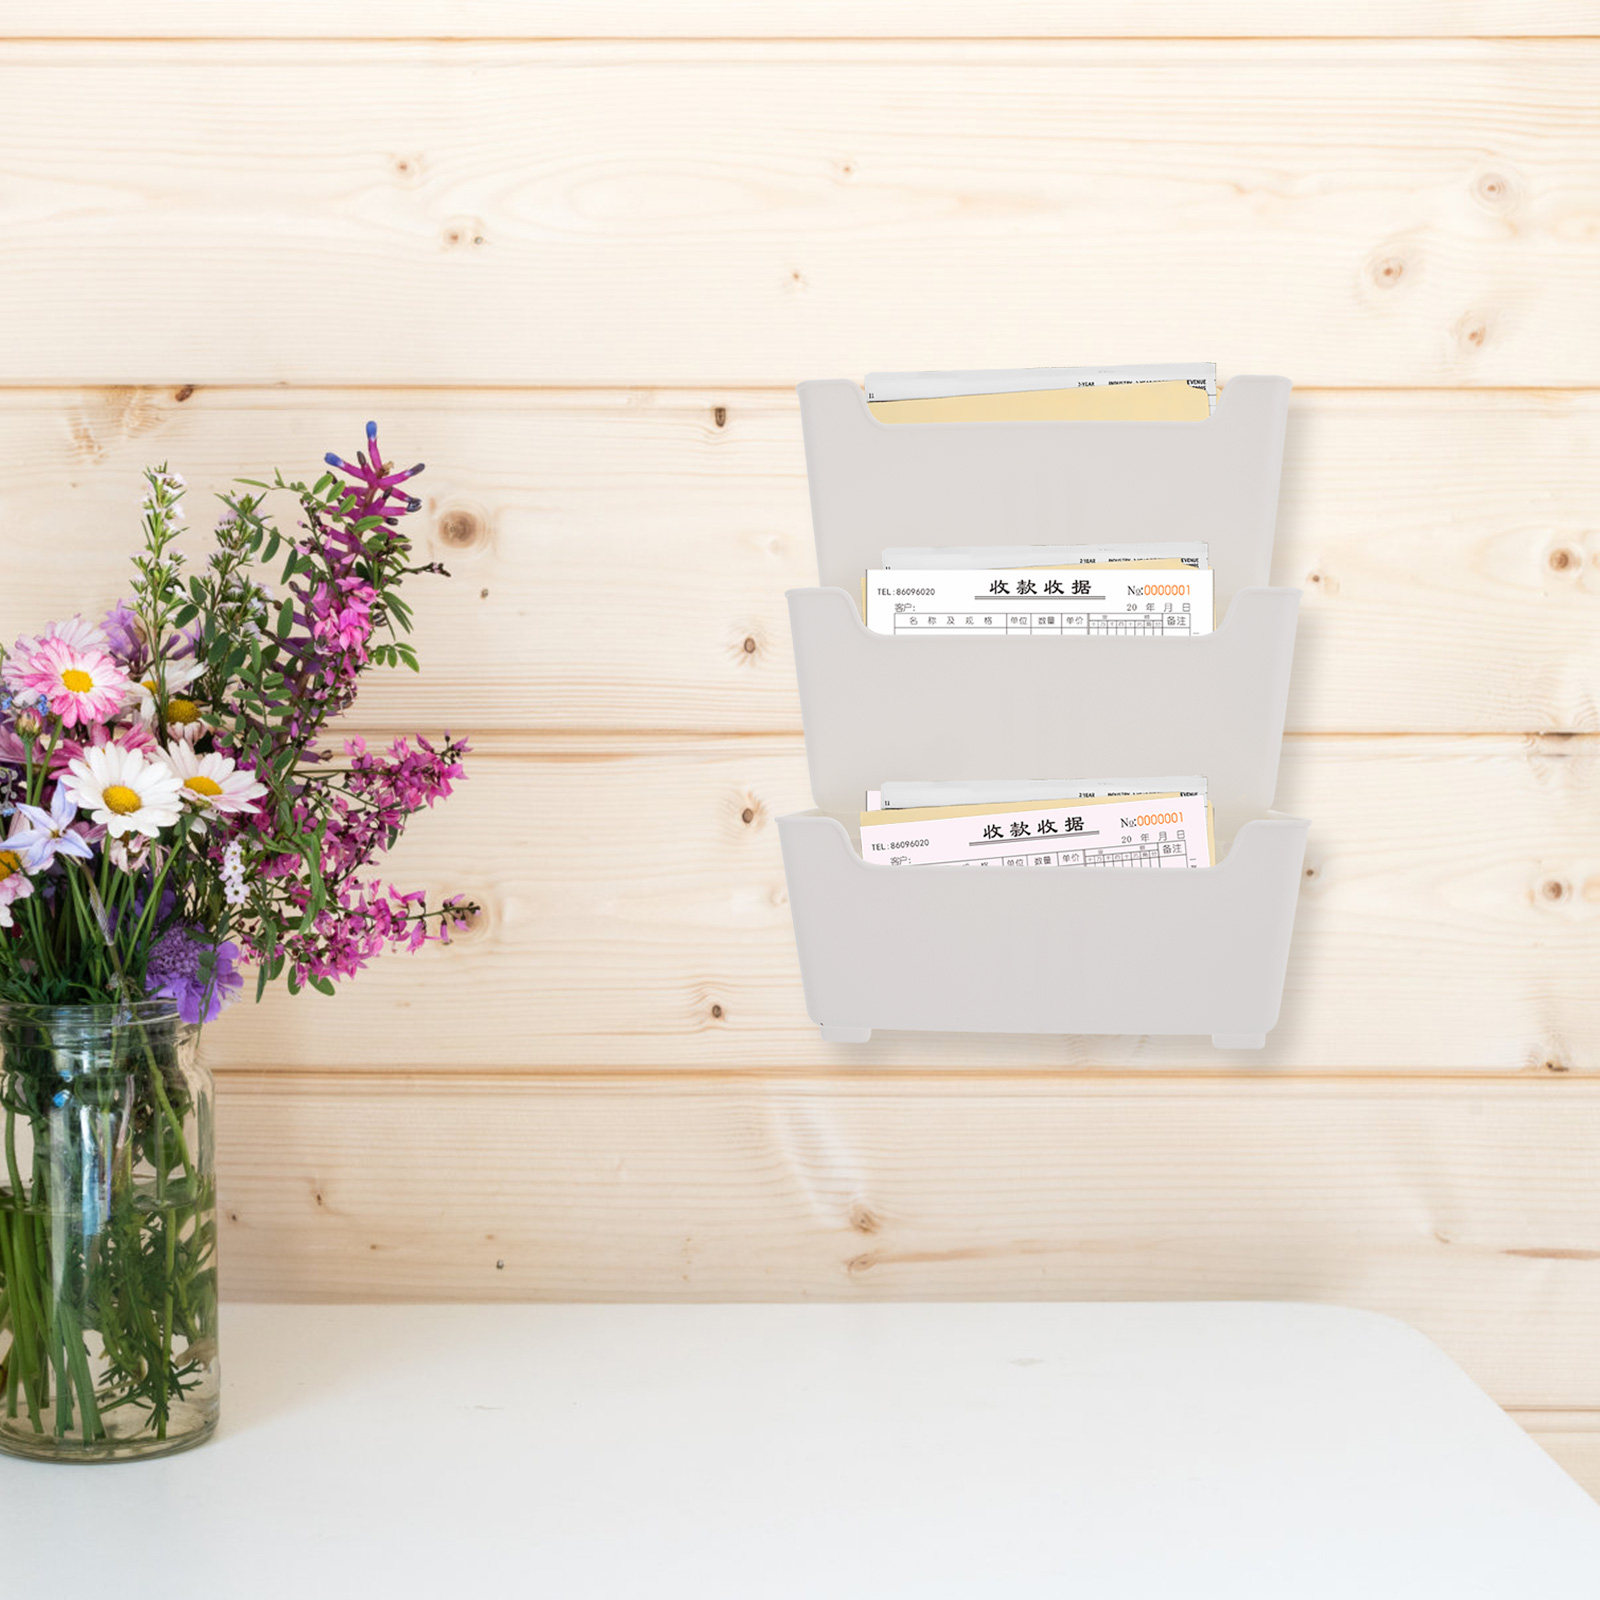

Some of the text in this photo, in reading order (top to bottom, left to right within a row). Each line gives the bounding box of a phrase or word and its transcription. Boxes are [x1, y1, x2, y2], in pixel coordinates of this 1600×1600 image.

[989, 579, 1092, 595] 收款收据
[1126, 602, 1191, 613] 20 年 月 日
[1167, 616, 1187, 626] 备注
[983, 816, 1085, 840] 收款收据
[1121, 830, 1186, 844] 20 年 月 日
[1162, 844, 1182, 855] 备注
